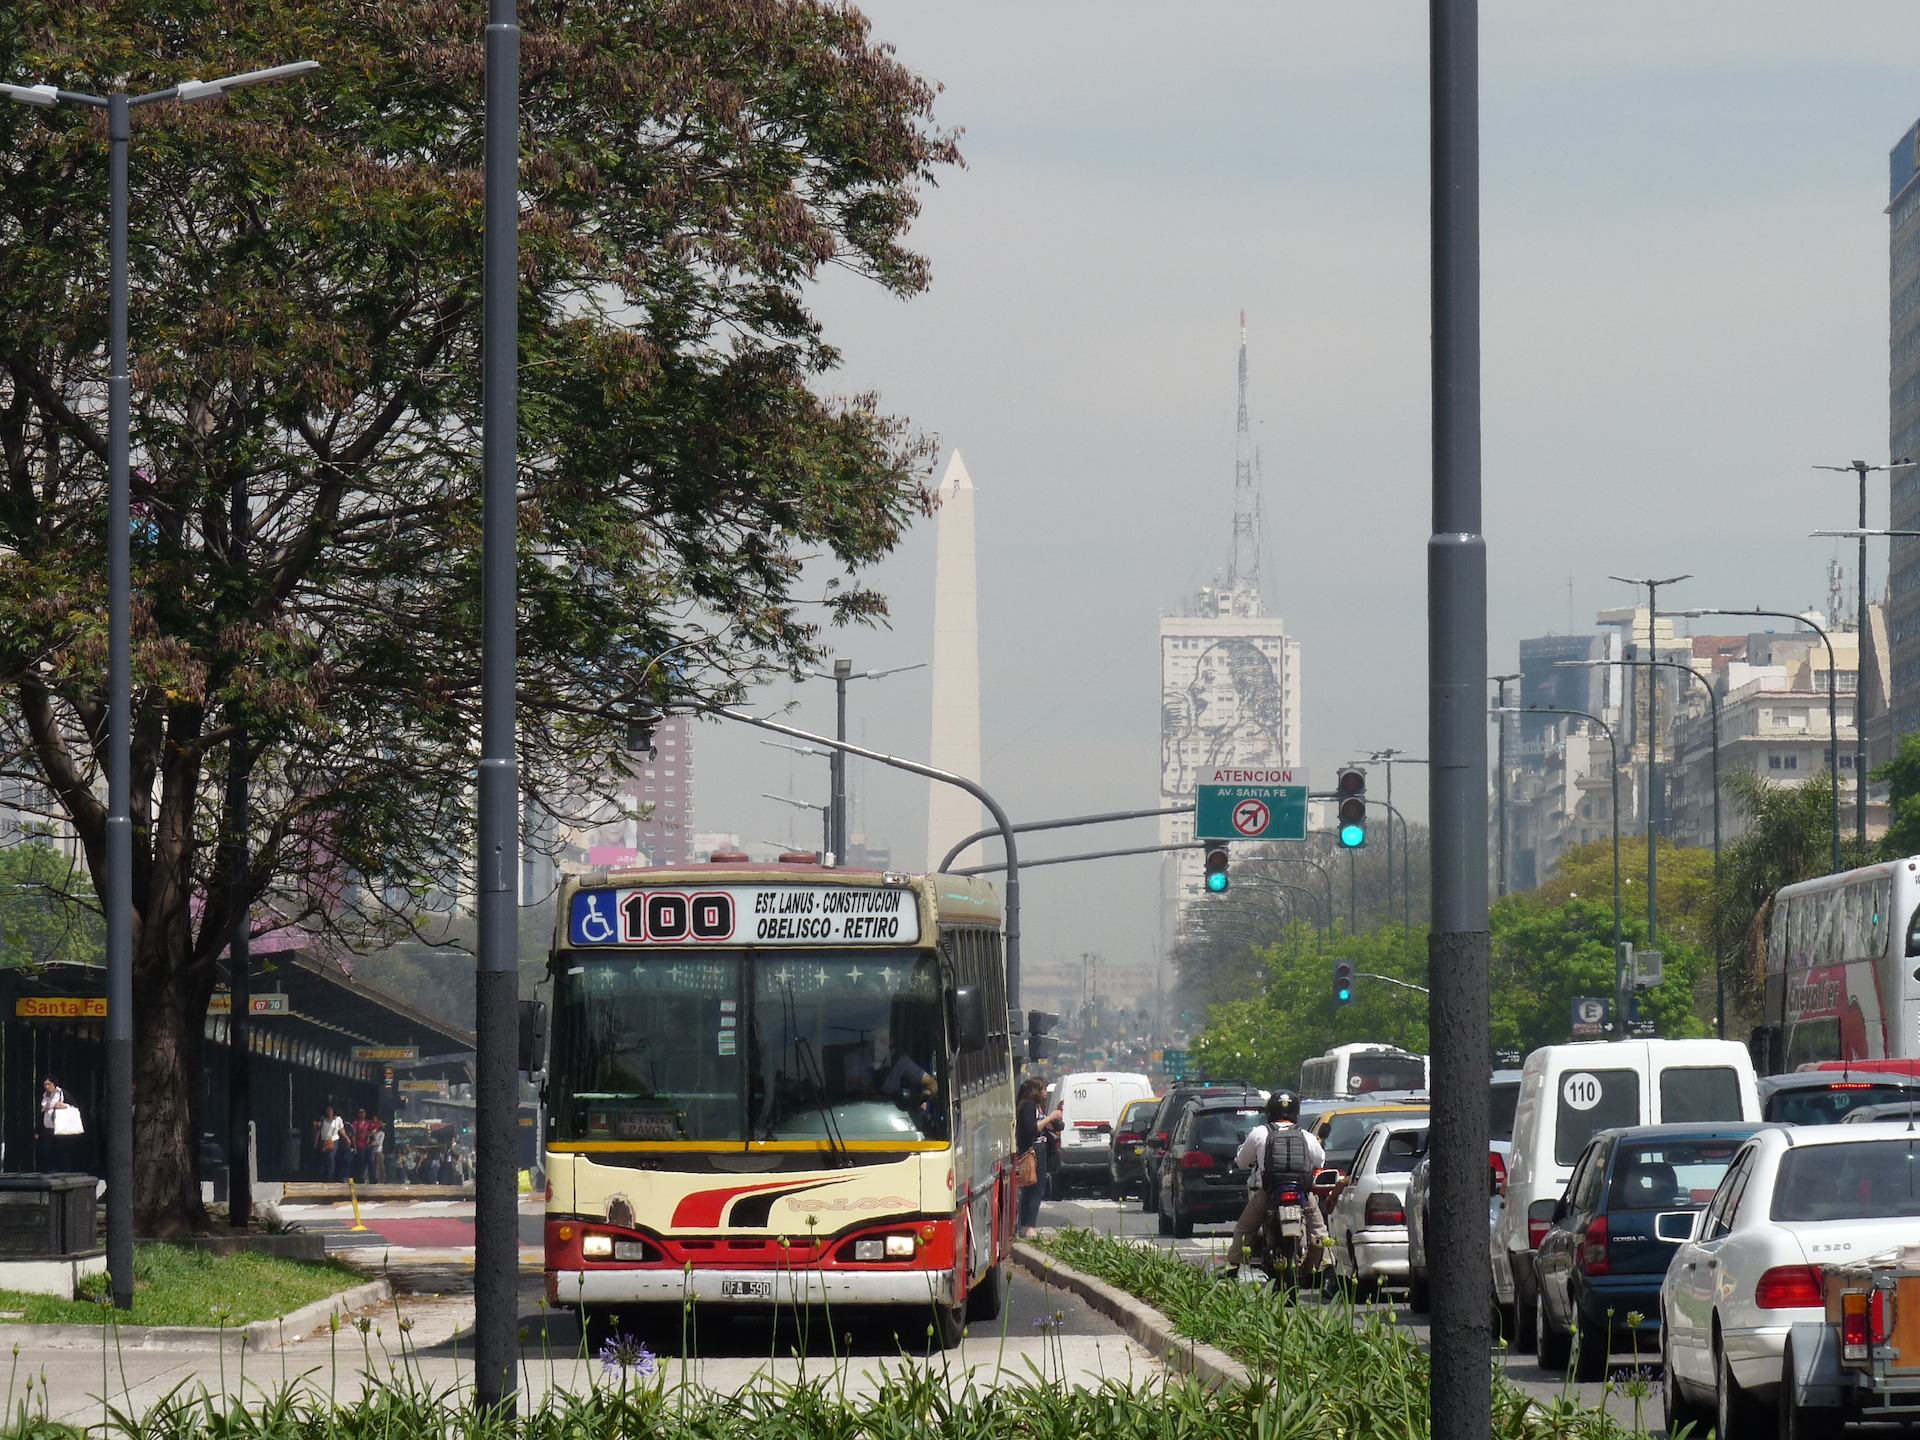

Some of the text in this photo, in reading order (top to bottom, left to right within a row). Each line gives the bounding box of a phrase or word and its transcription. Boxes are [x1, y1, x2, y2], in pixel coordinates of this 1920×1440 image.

[1213, 770, 1292, 782] ATENCION
[1217, 788, 1286, 797] AV. SANTA FE
[755, 892, 776, 914] EST.
[778, 892, 814, 914] LANUS
[822, 891, 901, 914] CONSTITUCION
[620, 891, 735, 942] 100
[757, 917, 831, 939] OBELISCO
[843, 916, 899, 939] RETIRO
[25, 999, 105, 1014] Santa Fe
[255, 1001, 266, 1010] 67
[269, 1001, 281, 1009] 70
[1585, 1003, 1598, 1019] E
[1073, 1089, 1087, 1099] 110
[1570, 1081, 1596, 1102] 110
[619, 1115, 672, 1125] RETIRO
[1812, 1243, 1852, 1252] E 320
[749, 1281, 770, 1295] 590
